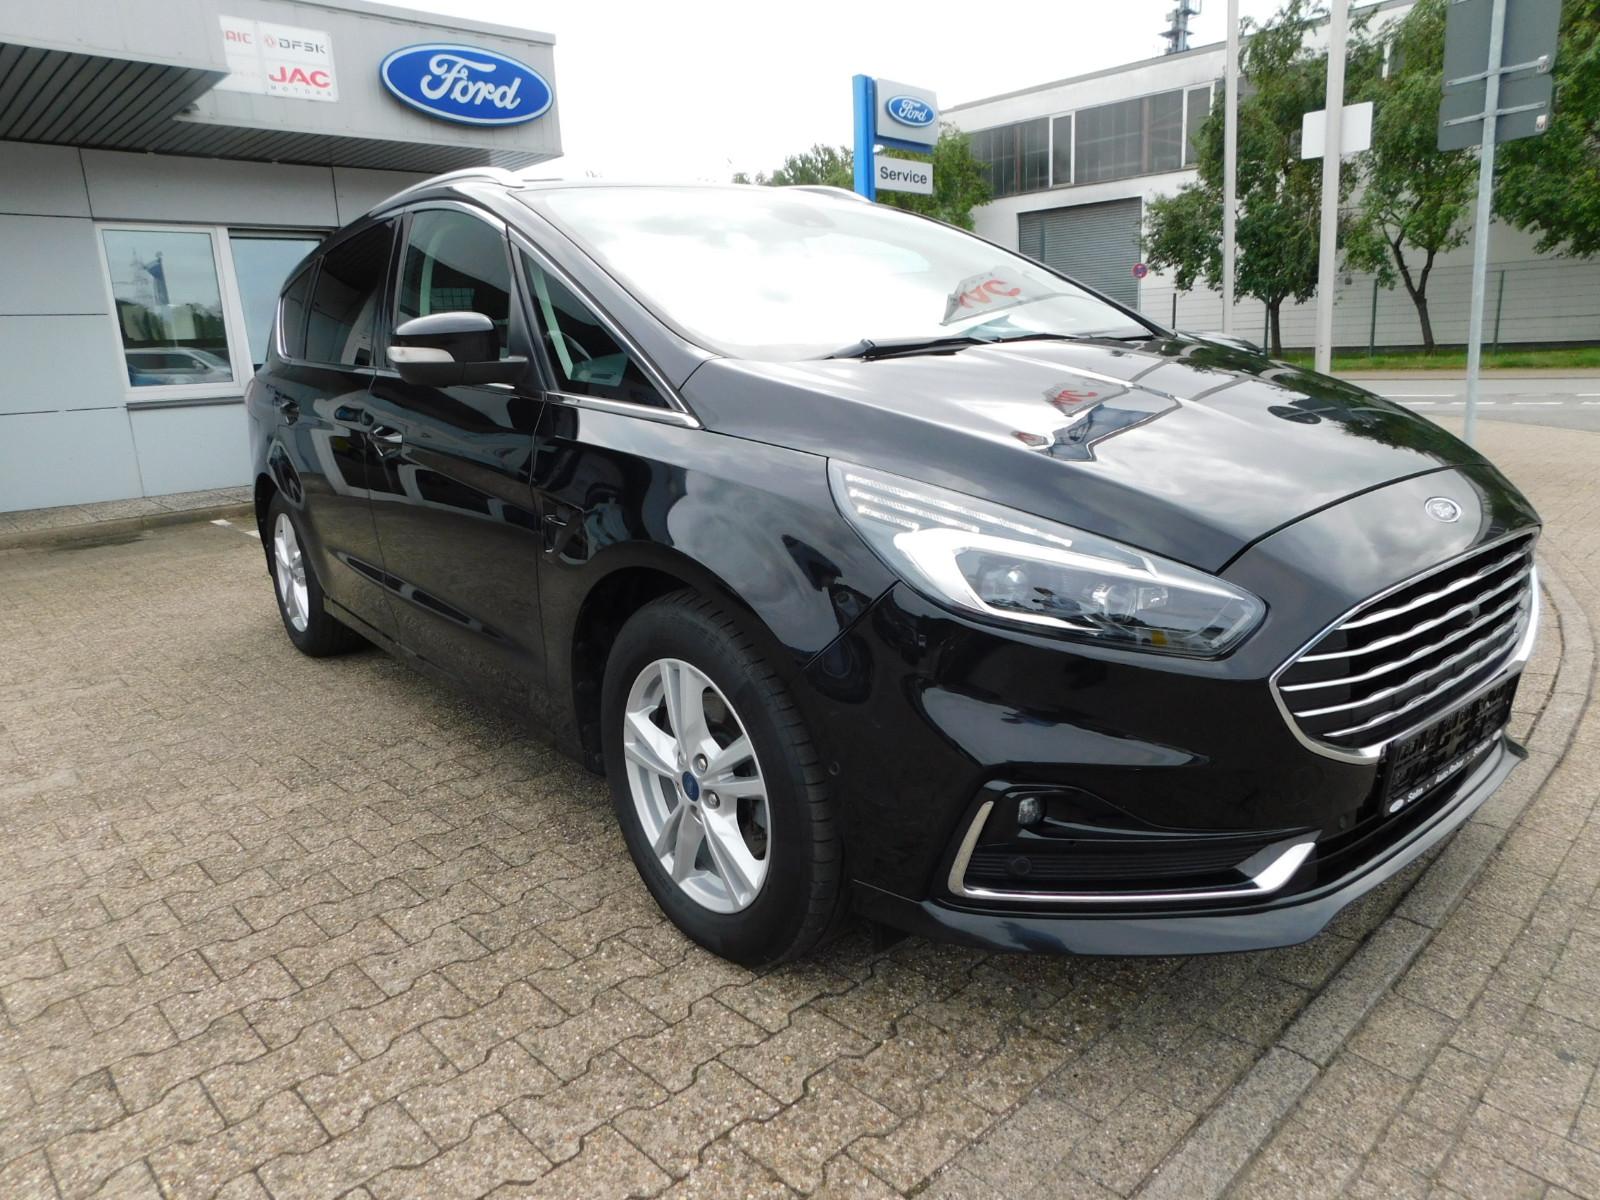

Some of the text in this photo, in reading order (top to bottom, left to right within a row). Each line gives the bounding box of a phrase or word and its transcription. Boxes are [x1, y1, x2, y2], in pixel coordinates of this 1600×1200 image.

[224, 30, 253, 45] AIC
[278, 37, 327, 55] DFSK
[268, 65, 331, 89] JAC
[420, 53, 522, 110] Ford
[898, 99, 928, 122] Ford
[880, 166, 928, 185] Service
